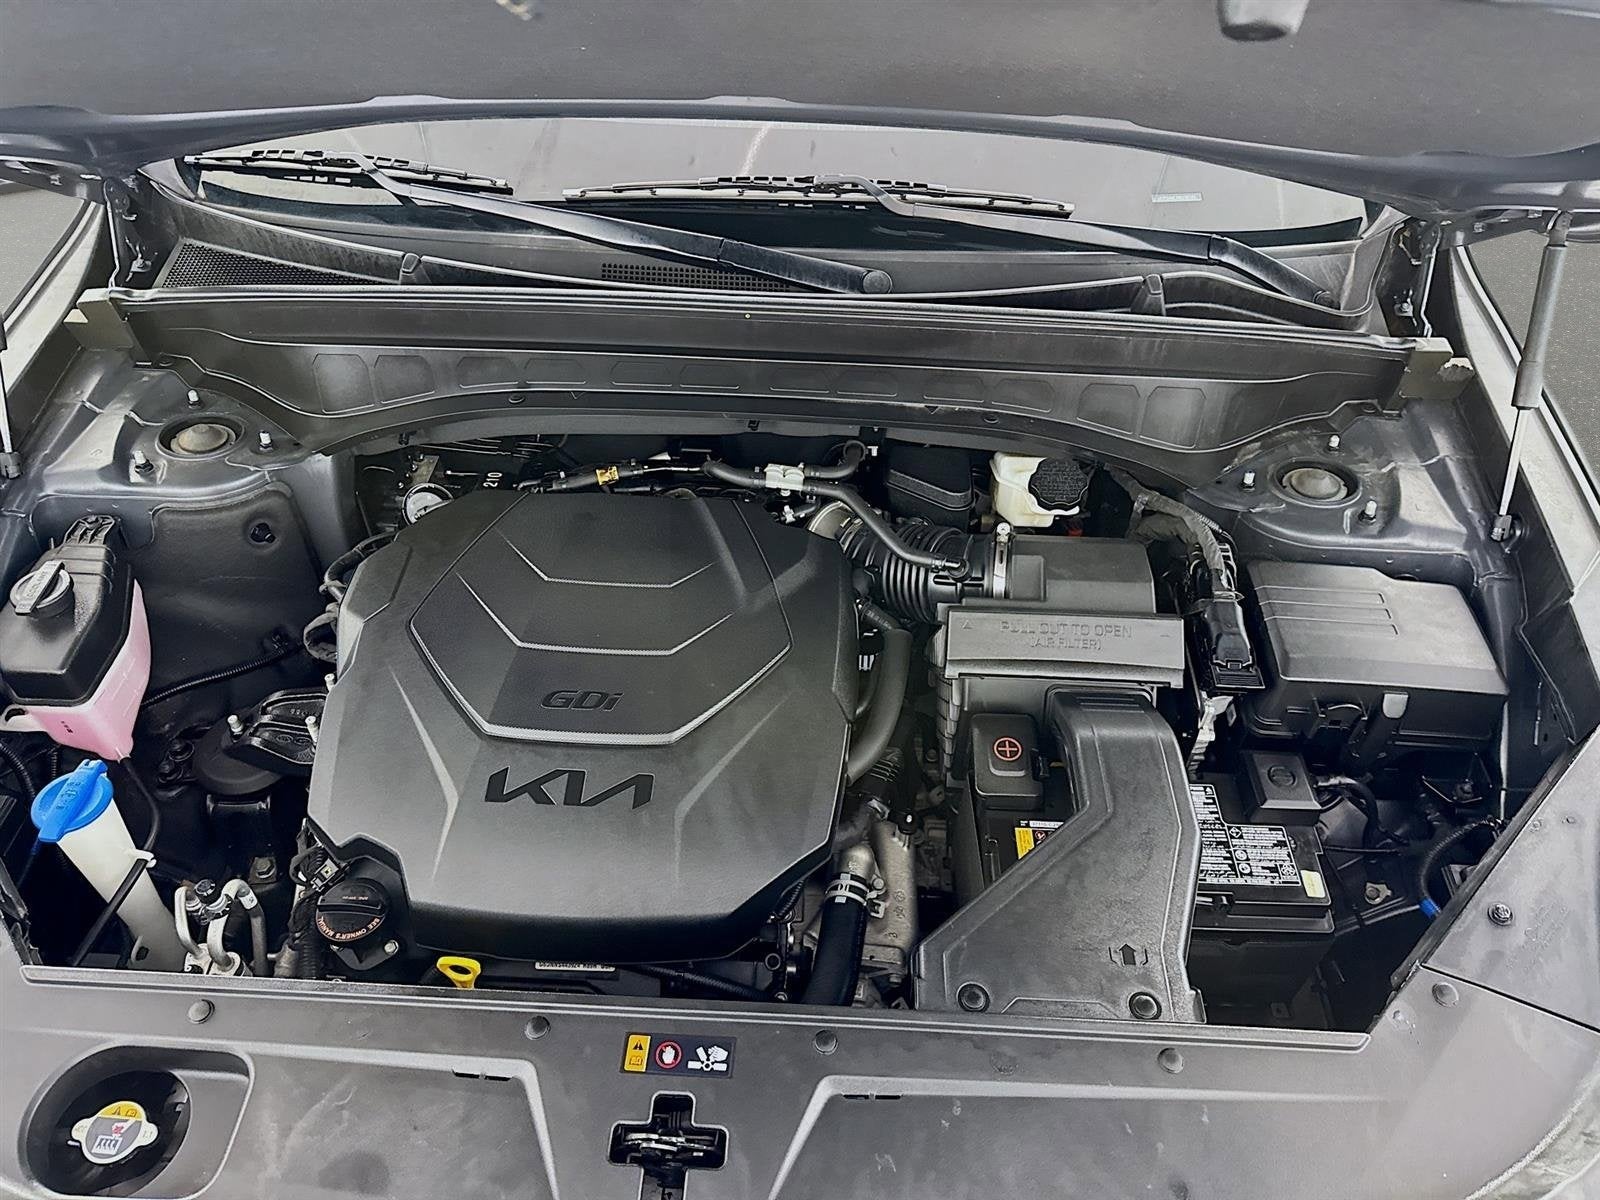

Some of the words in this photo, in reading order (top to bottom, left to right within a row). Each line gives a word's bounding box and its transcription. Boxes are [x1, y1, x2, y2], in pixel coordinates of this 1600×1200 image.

[483, 472, 502, 487] 210
[1039, 622, 1069, 635] OUT
[1071, 623, 1090, 637] TO
[1094, 624, 1134, 640] OPEN
[541, 689, 624, 712] GDi
[318, 916, 335, 936] MANUAL
[367, 918, 380, 930] SEE
[335, 928, 367, 939] OWNER'S
